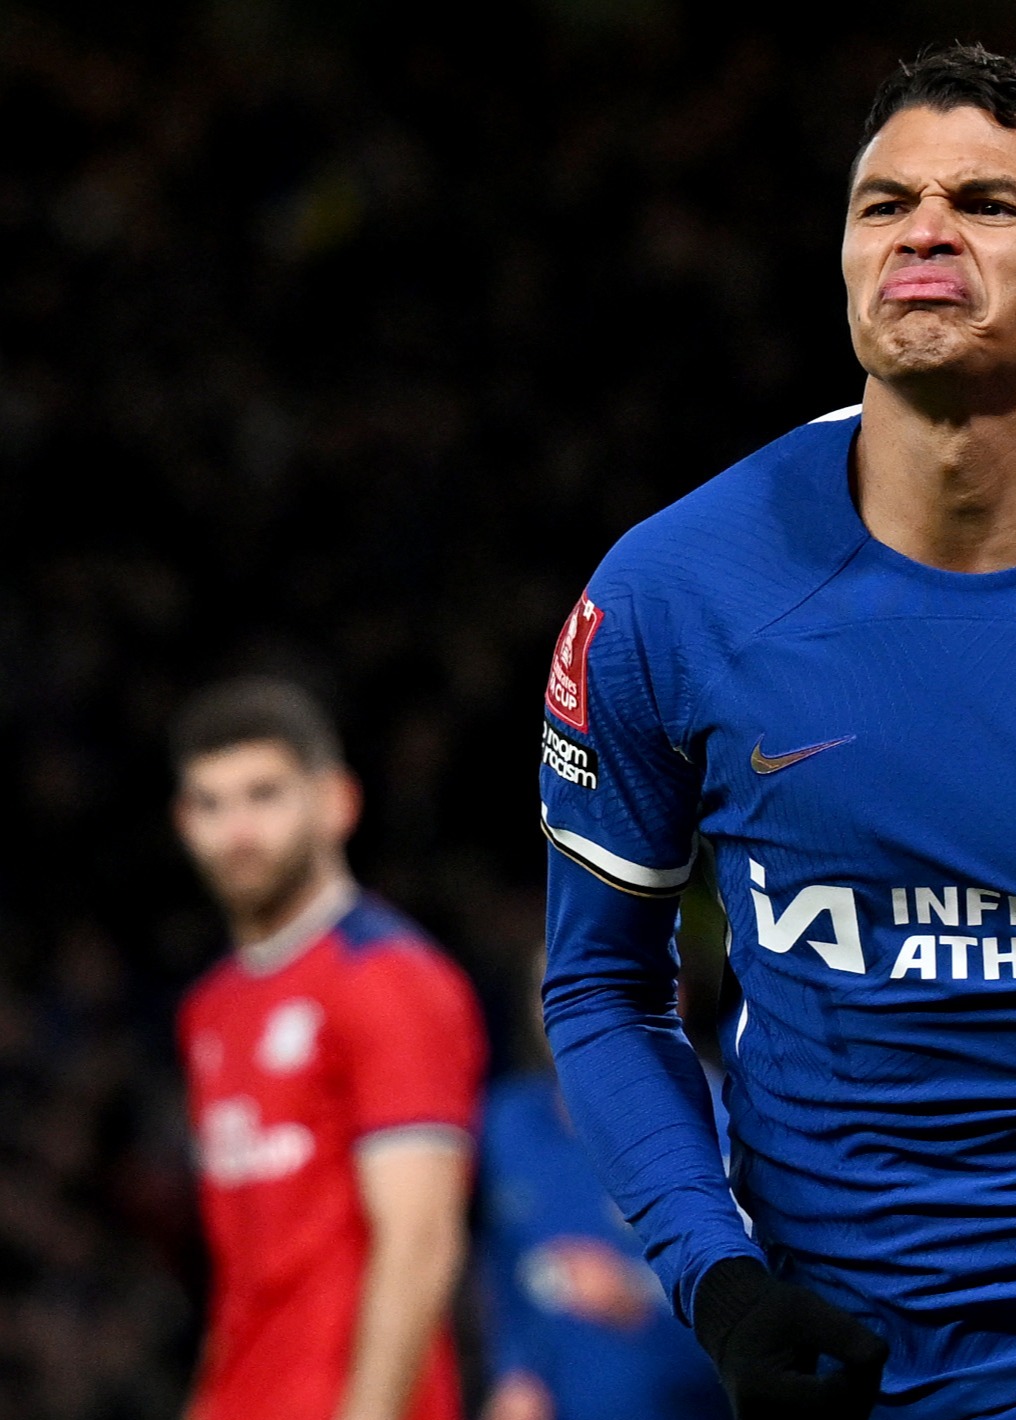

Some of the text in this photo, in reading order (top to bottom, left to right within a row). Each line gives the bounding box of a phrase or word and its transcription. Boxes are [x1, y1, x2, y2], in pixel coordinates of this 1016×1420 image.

[555, 683, 577, 710] CUP
[542, 745, 597, 790] racism
[547, 727, 588, 768] room
